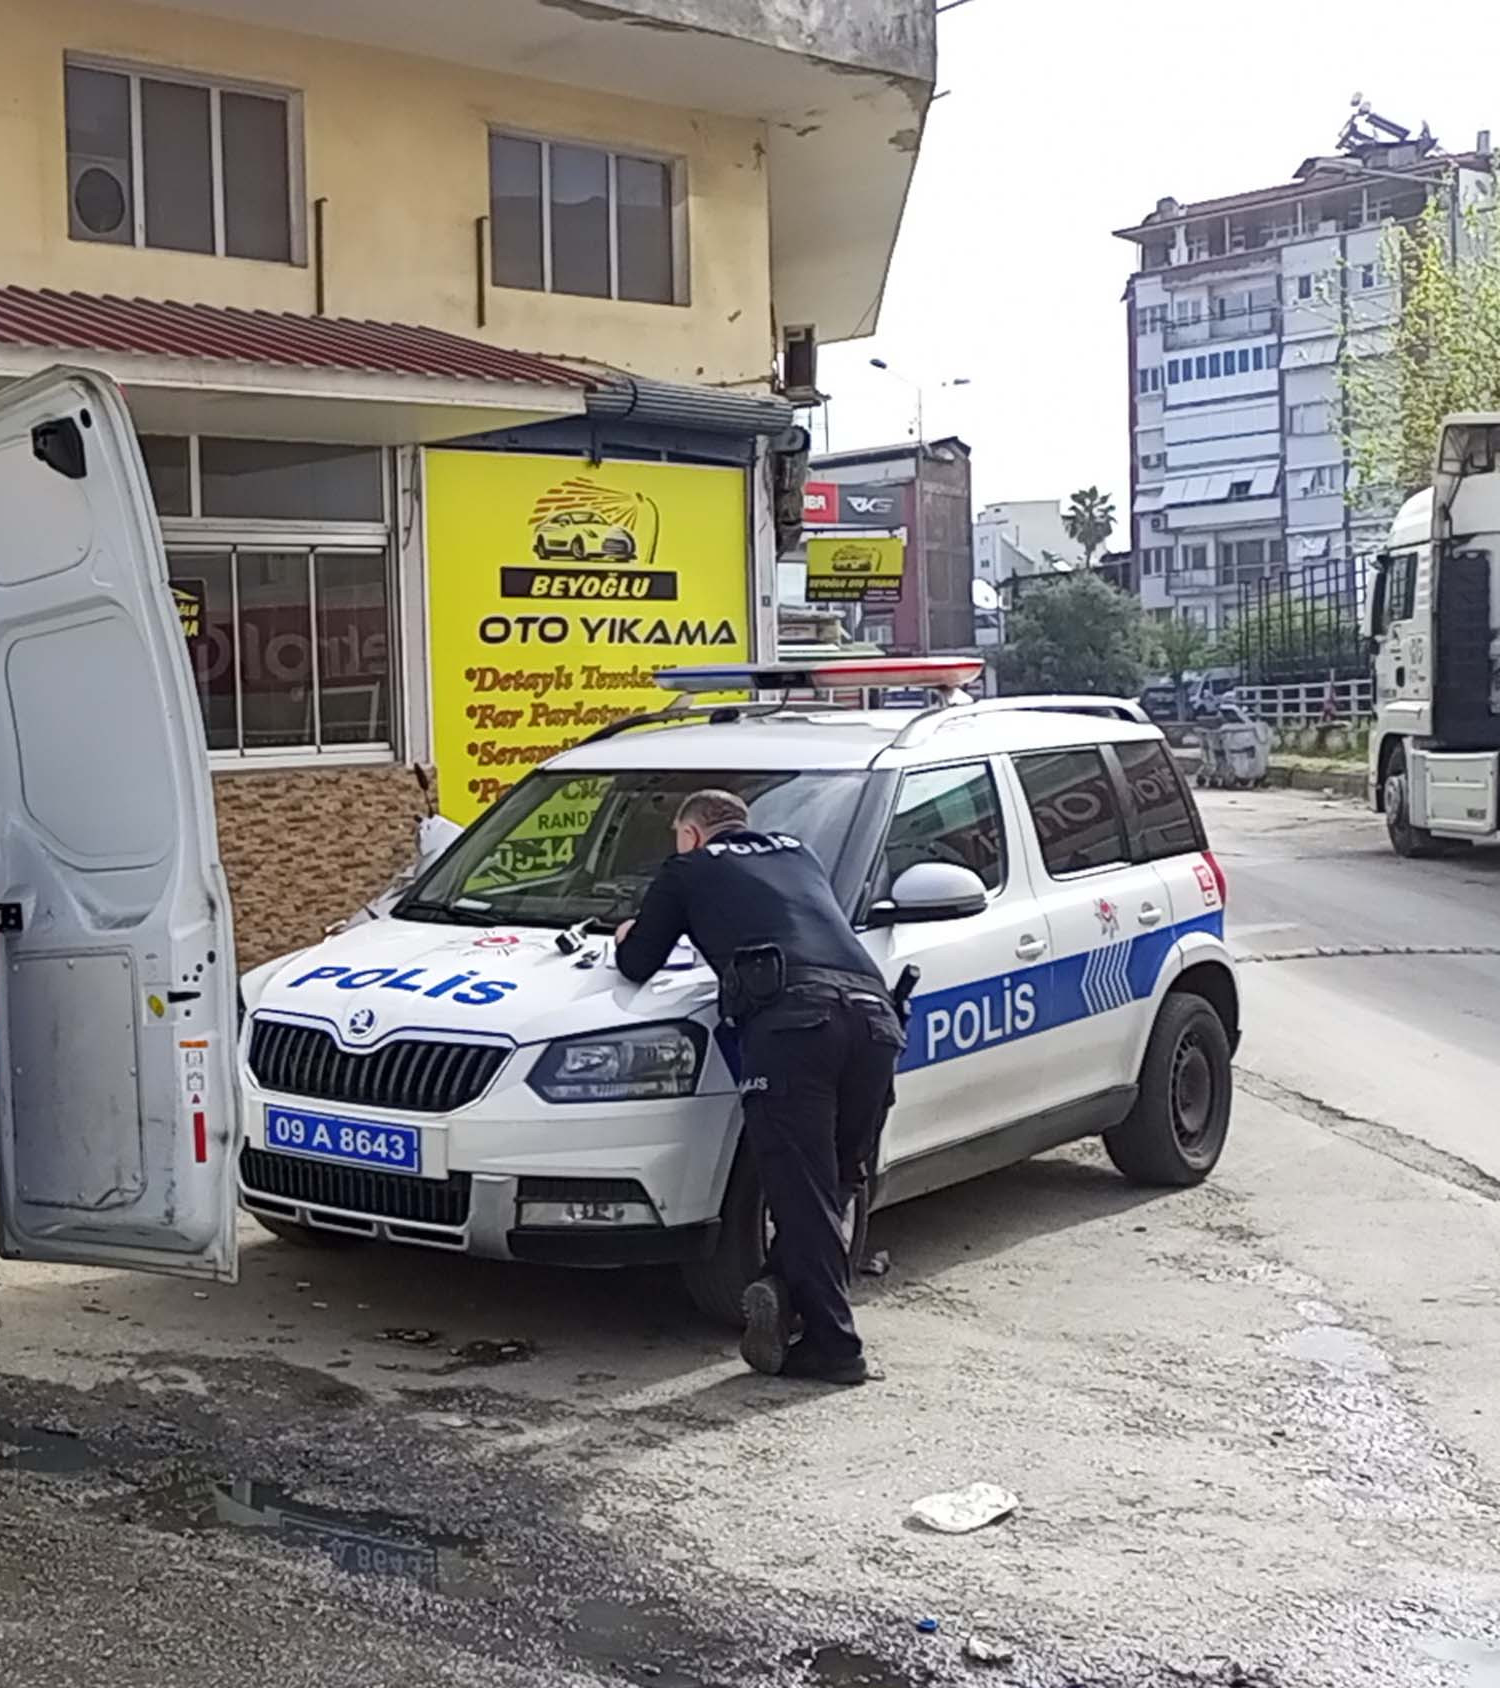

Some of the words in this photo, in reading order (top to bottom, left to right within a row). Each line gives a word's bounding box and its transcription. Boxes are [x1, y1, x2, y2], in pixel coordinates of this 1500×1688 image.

[530, 573, 651, 598] BEYOĞLU
[479, 616, 569, 645] OTO
[580, 617, 737, 646] YIKAMA
[287, 966, 518, 1005] POLİS
[926, 977, 1036, 1060] POLİS
[275, 1117, 305, 1143] 09
[311, 1124, 333, 1149] A
[339, 1130, 406, 1160] 8643
